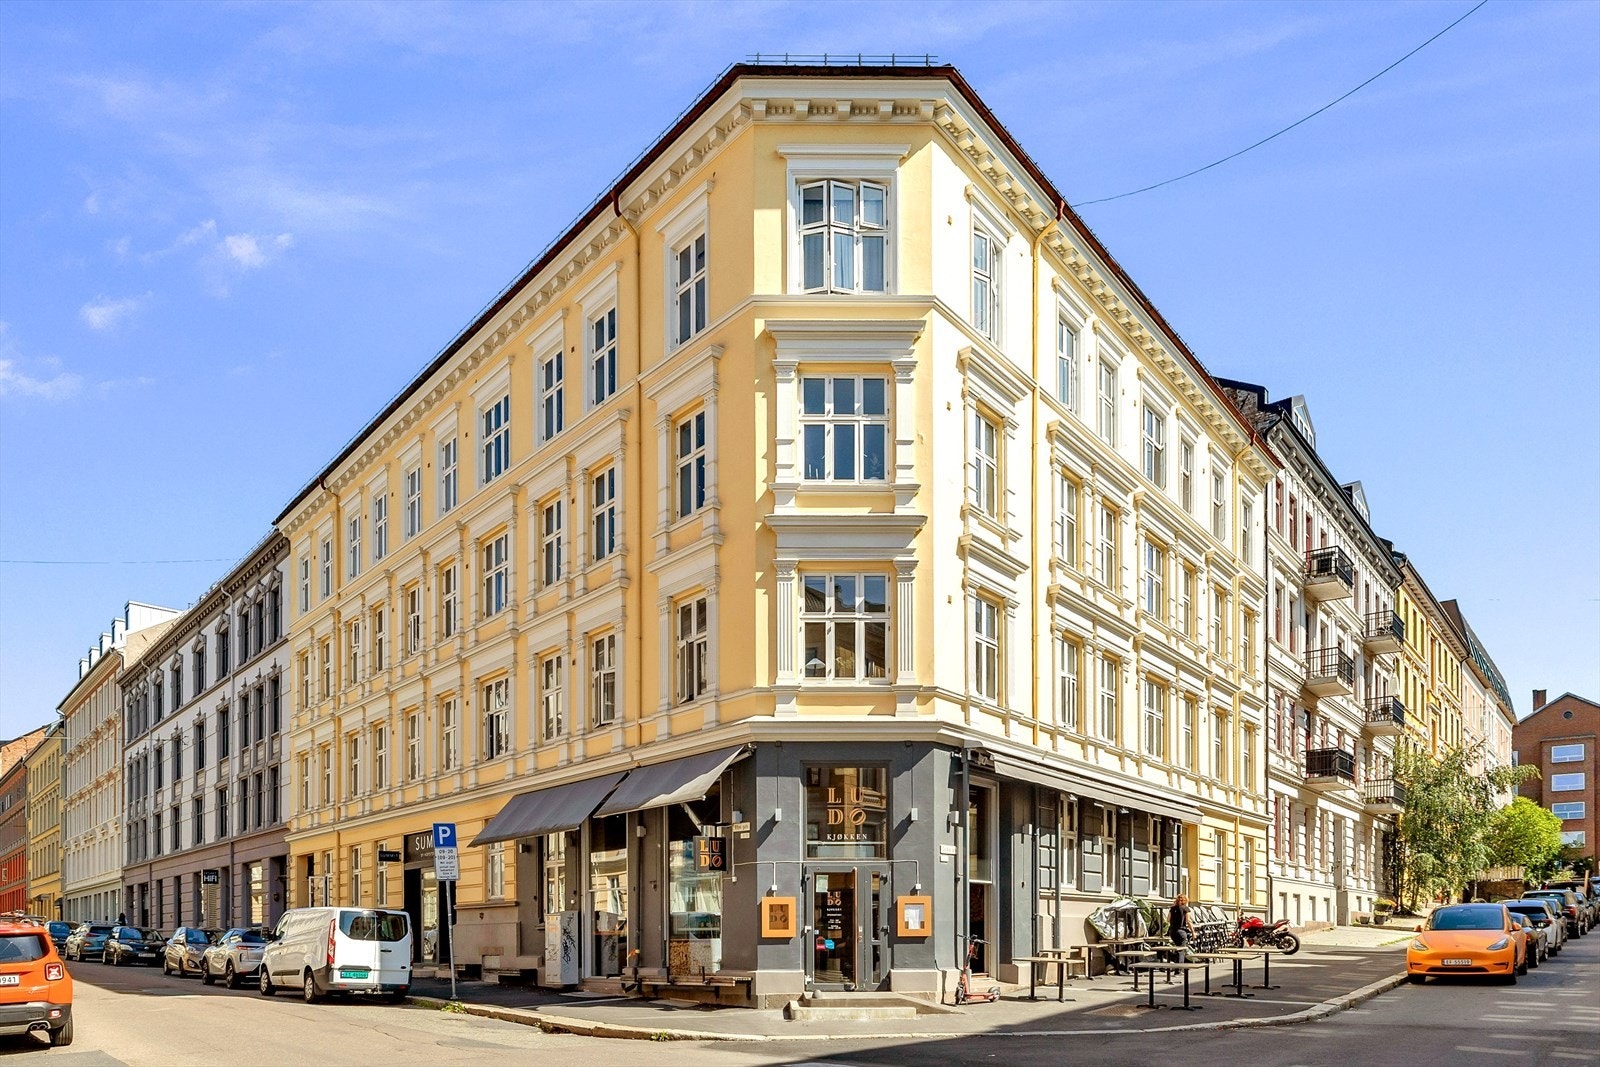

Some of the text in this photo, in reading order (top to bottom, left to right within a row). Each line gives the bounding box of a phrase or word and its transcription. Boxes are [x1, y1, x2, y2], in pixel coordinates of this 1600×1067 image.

[415, 835, 433, 850] SUM
[438, 826, 451, 845] P
[826, 833, 868, 841] KJØKKEN
